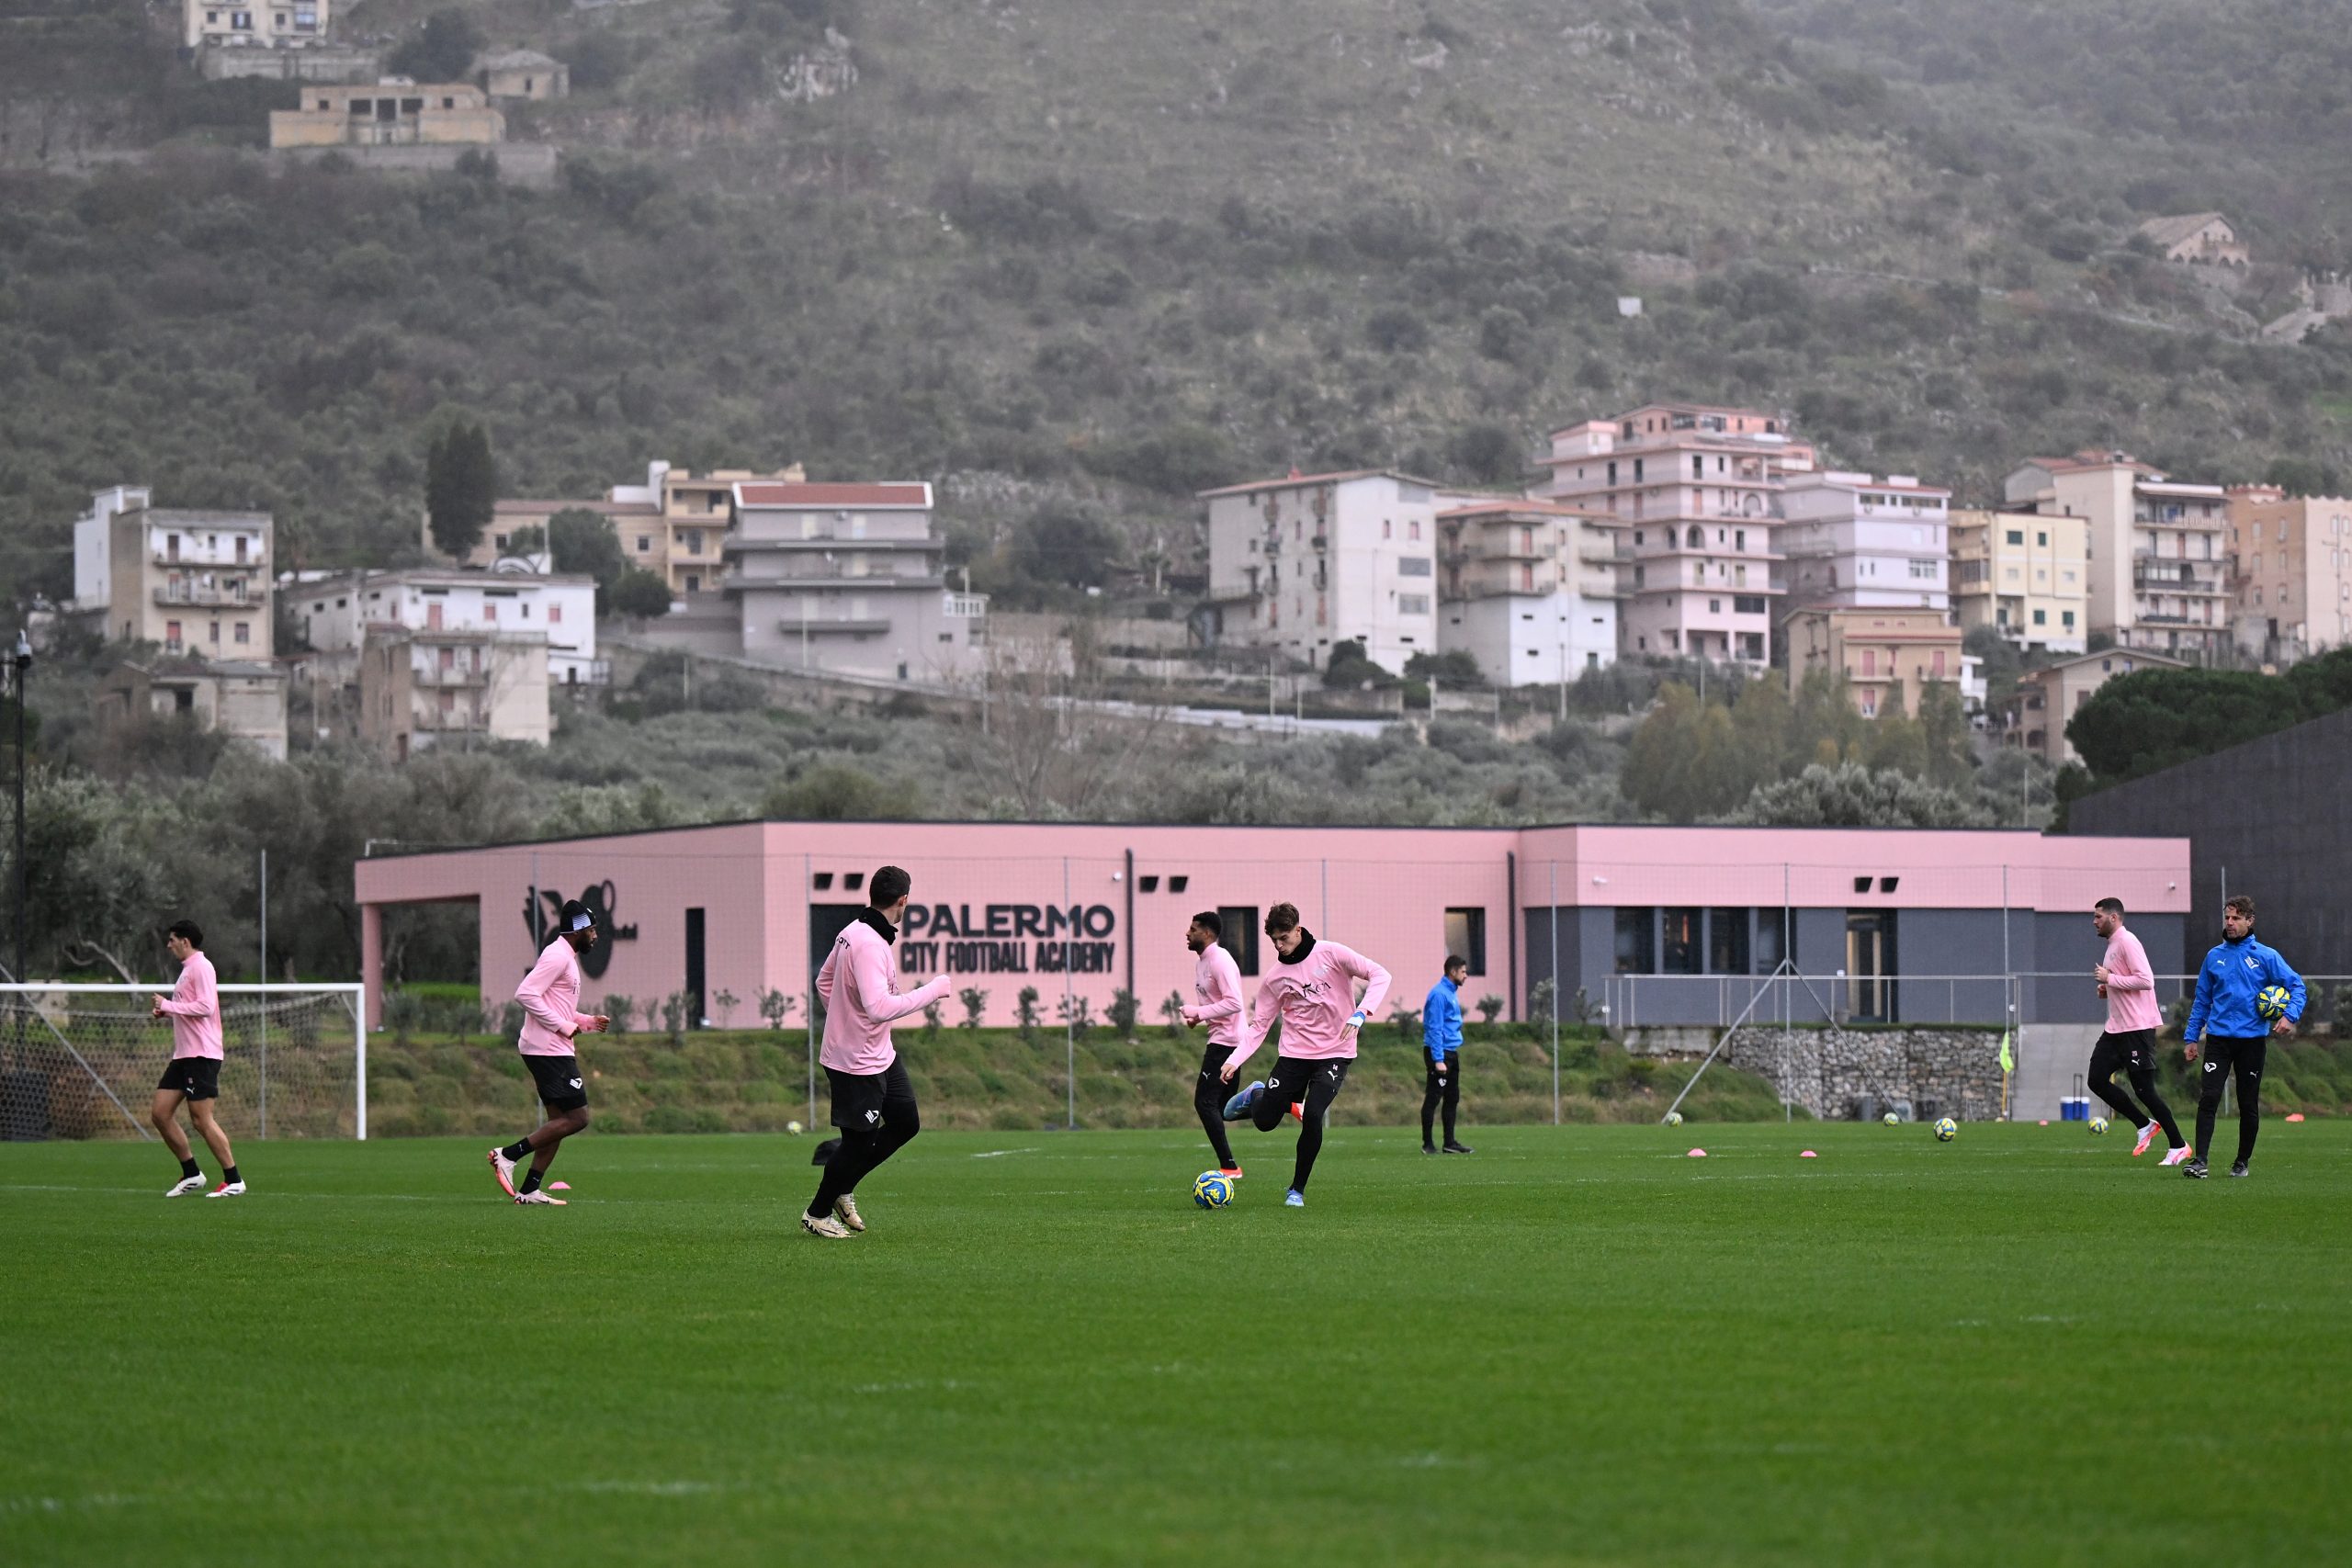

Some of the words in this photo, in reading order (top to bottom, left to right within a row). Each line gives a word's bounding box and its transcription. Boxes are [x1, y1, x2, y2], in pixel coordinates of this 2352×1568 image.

[902, 904, 1114, 937] PALERMO
[900, 942, 939, 973] CITY
[945, 942, 1028, 973] FOOTBALL
[1035, 942, 1114, 973] ACADEMY
